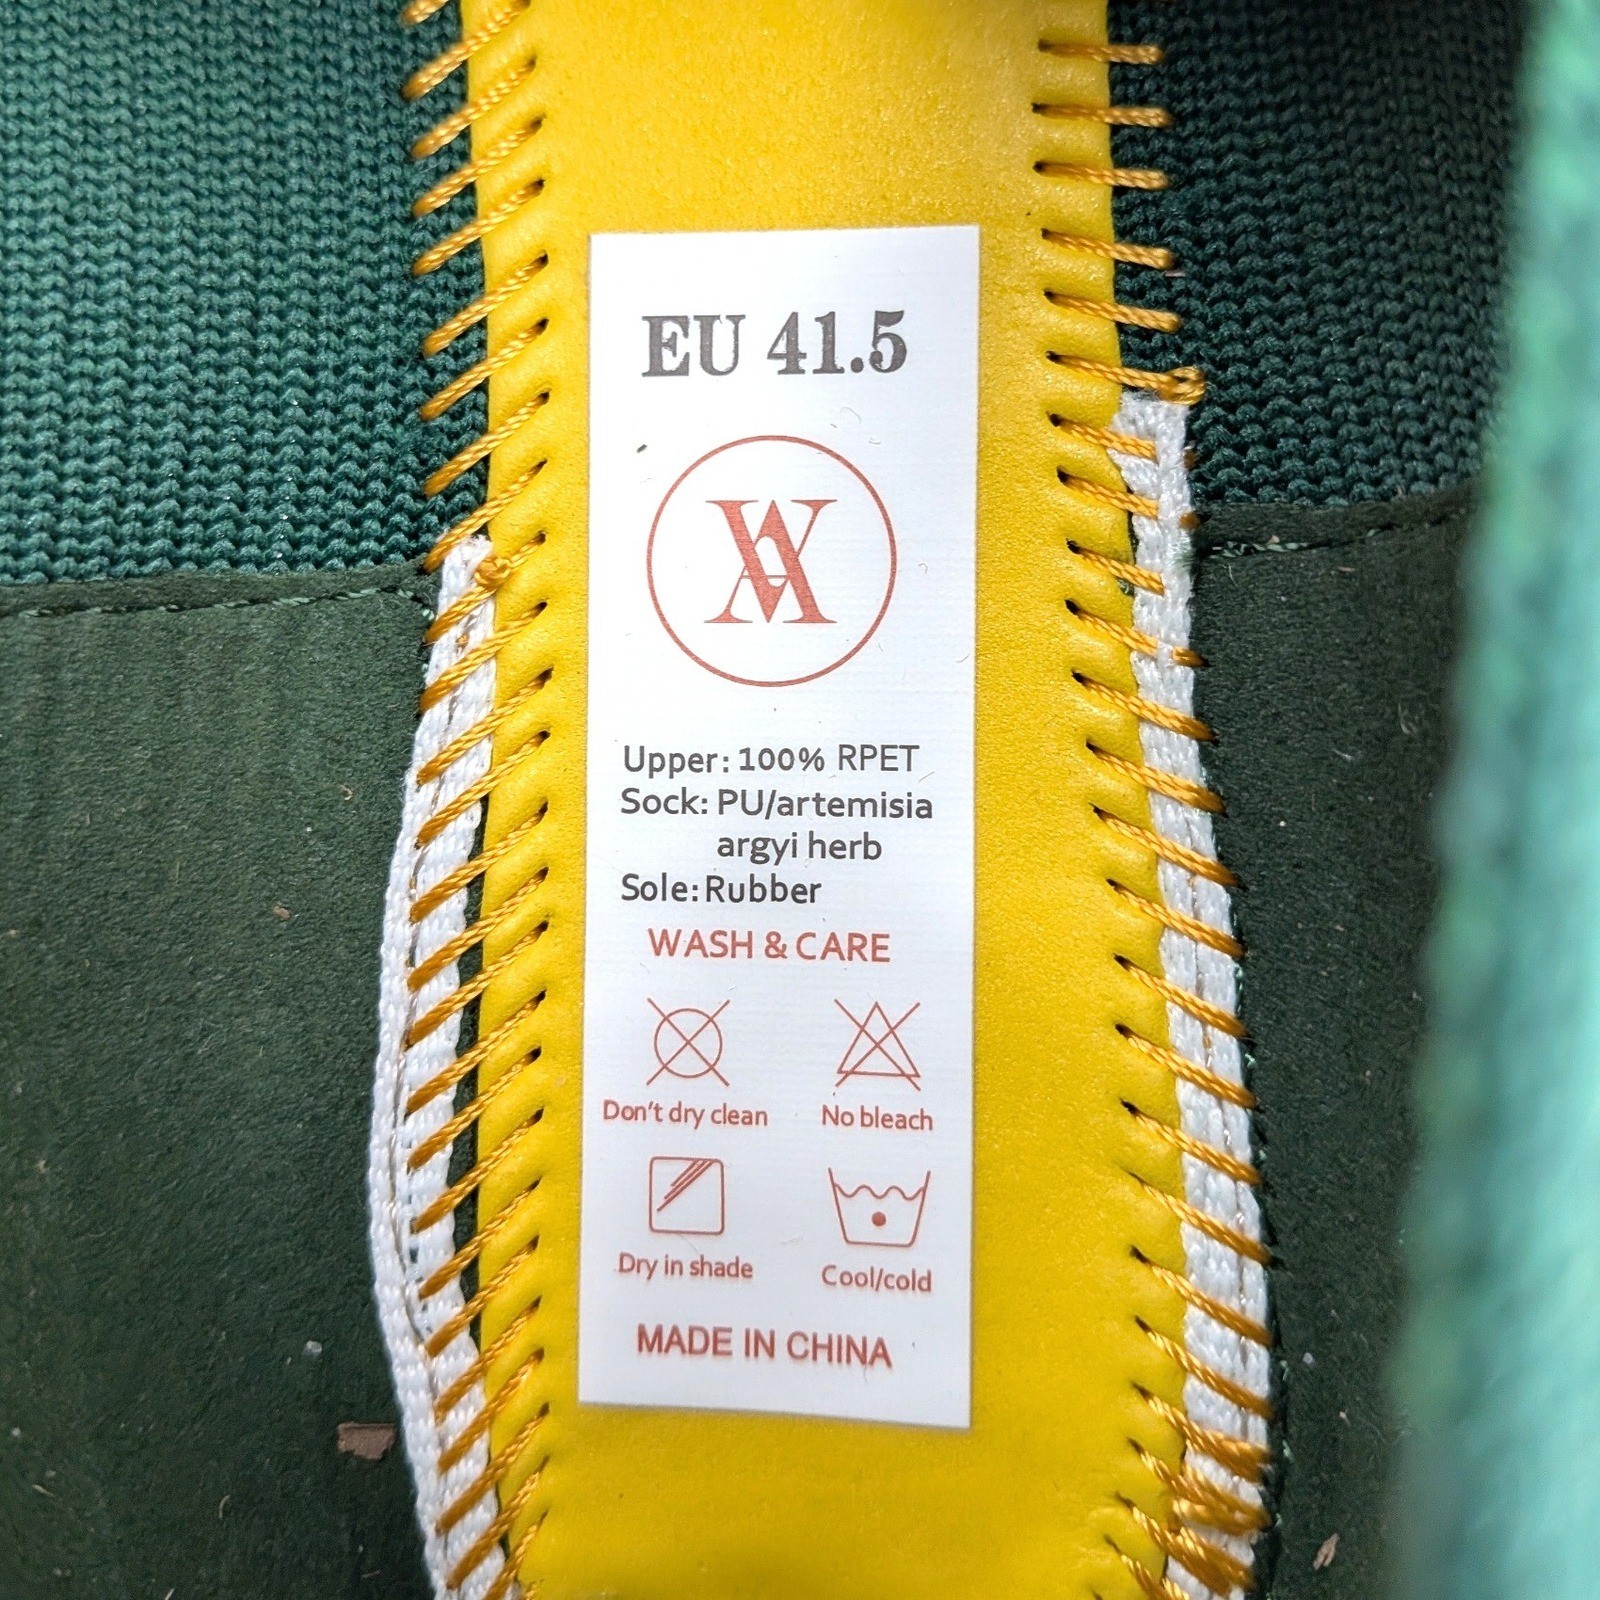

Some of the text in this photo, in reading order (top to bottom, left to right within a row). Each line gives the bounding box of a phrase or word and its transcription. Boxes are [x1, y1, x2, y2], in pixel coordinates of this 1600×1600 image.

[641, 310, 907, 377] EU 41.5
[624, 744, 920, 779] Upper: 100% RPET
[620, 787, 933, 820] Sock: PU/artemisia
[717, 830, 883, 866] argyi herb
[621, 872, 822, 904] Sole: Rubber
[647, 928, 891, 963] WASH & CARE
[669, 1101, 706, 1130] dry
[710, 1103, 768, 1126] clean
[821, 1104, 934, 1131] No bleach
[618, 1252, 754, 1281] Dry in shade
[821, 1264, 932, 1293] Cool/cold
[637, 1323, 893, 1369] MADE IN CHINA
